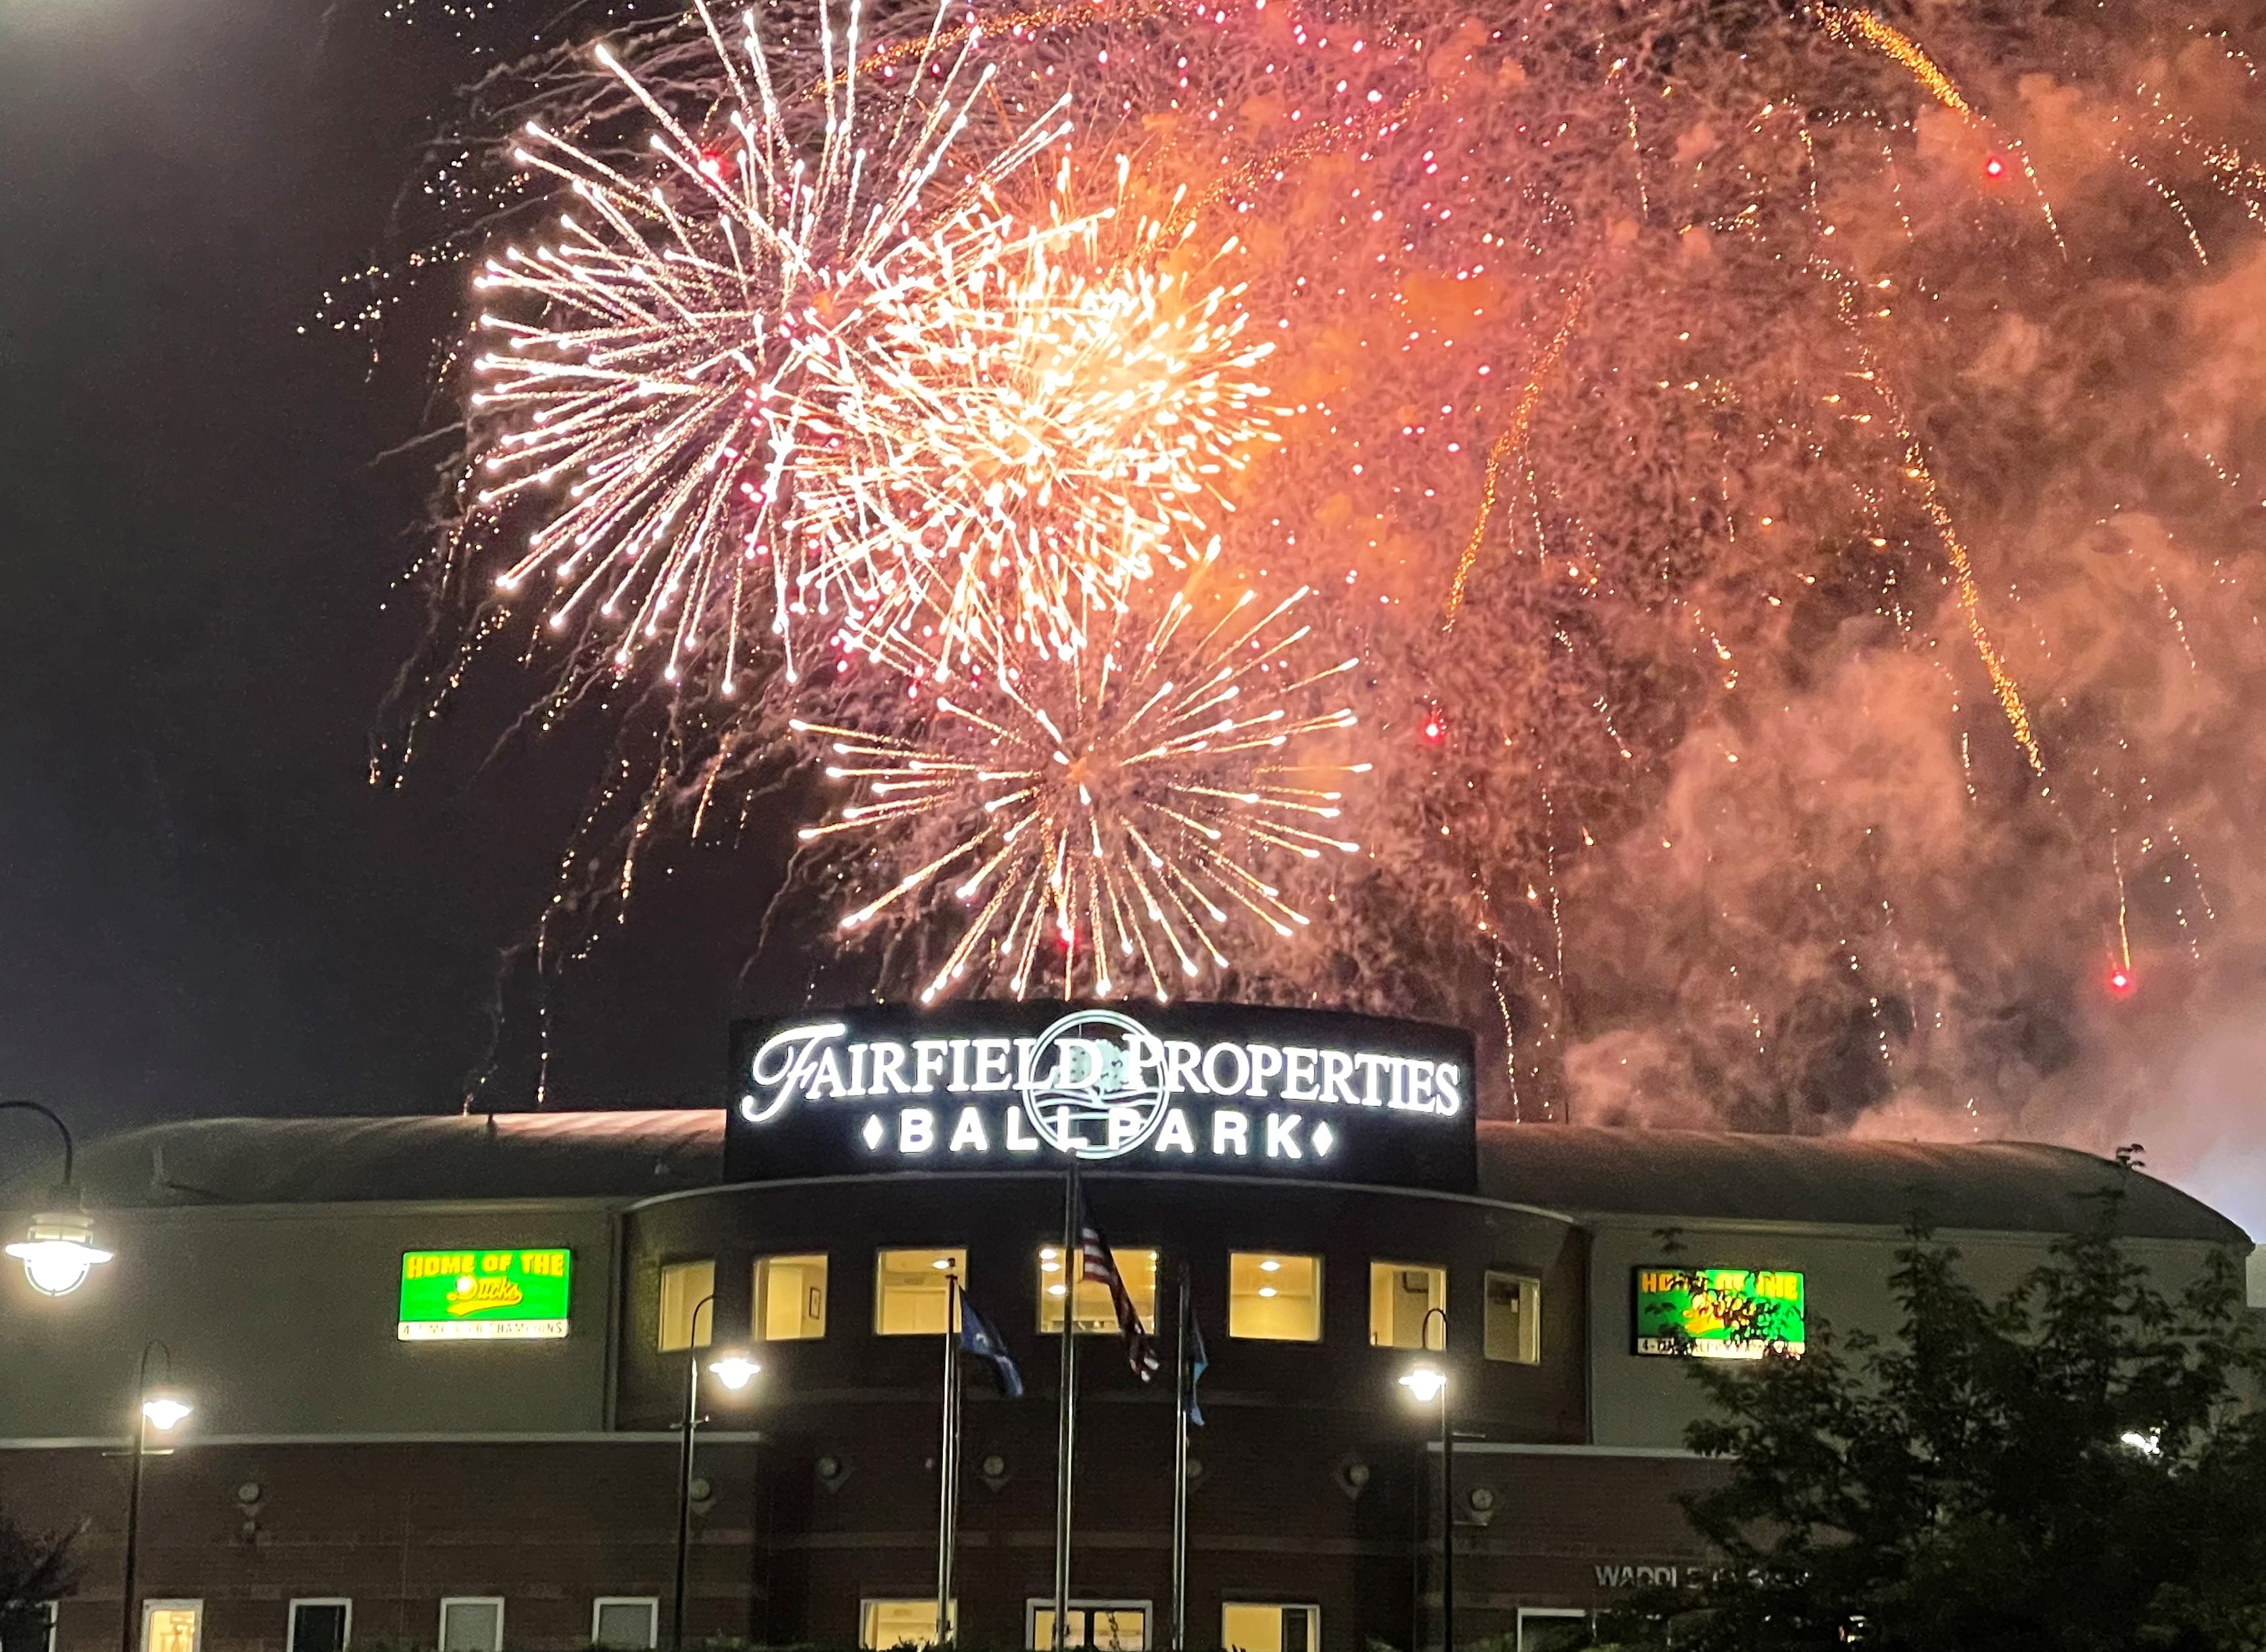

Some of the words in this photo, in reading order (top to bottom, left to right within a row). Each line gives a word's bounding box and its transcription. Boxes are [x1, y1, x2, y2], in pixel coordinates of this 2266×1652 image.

[740, 1022, 1103, 1123] FAIRFIELD
[1122, 1032, 1460, 1117] PROPERTIES
[406, 1253, 475, 1279] HOME
[481, 1253, 514, 1272] OF
[520, 1252, 565, 1277] THE
[445, 1273, 523, 1302] Ducks
[1641, 1272, 1708, 1294] HO
